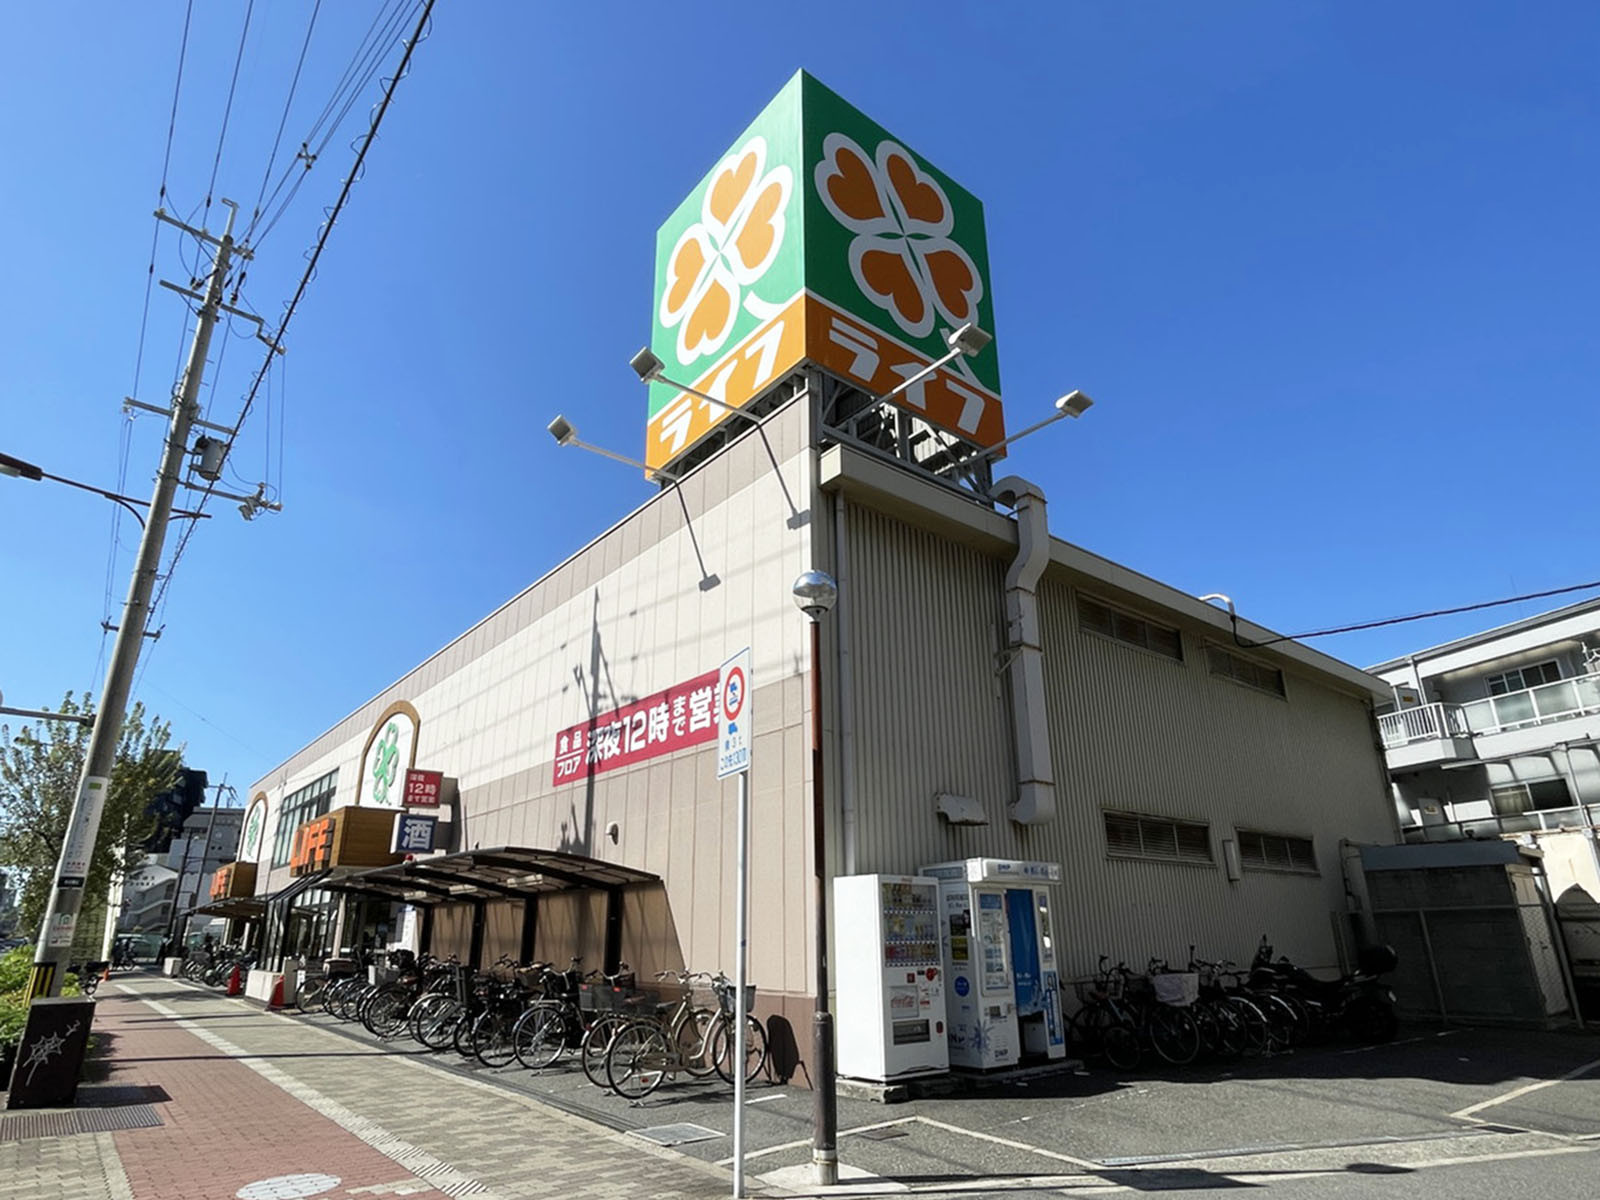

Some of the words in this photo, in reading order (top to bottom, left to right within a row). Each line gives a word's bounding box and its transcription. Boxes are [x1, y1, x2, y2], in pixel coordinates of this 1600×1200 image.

[659, 319, 785, 454] ライフ
[829, 317, 985, 436] ライフ
[559, 730, 582, 755] 食品
[557, 756, 582, 778] フロア
[290, 818, 331, 868] LIFE
[401, 818, 434, 850] 酒
